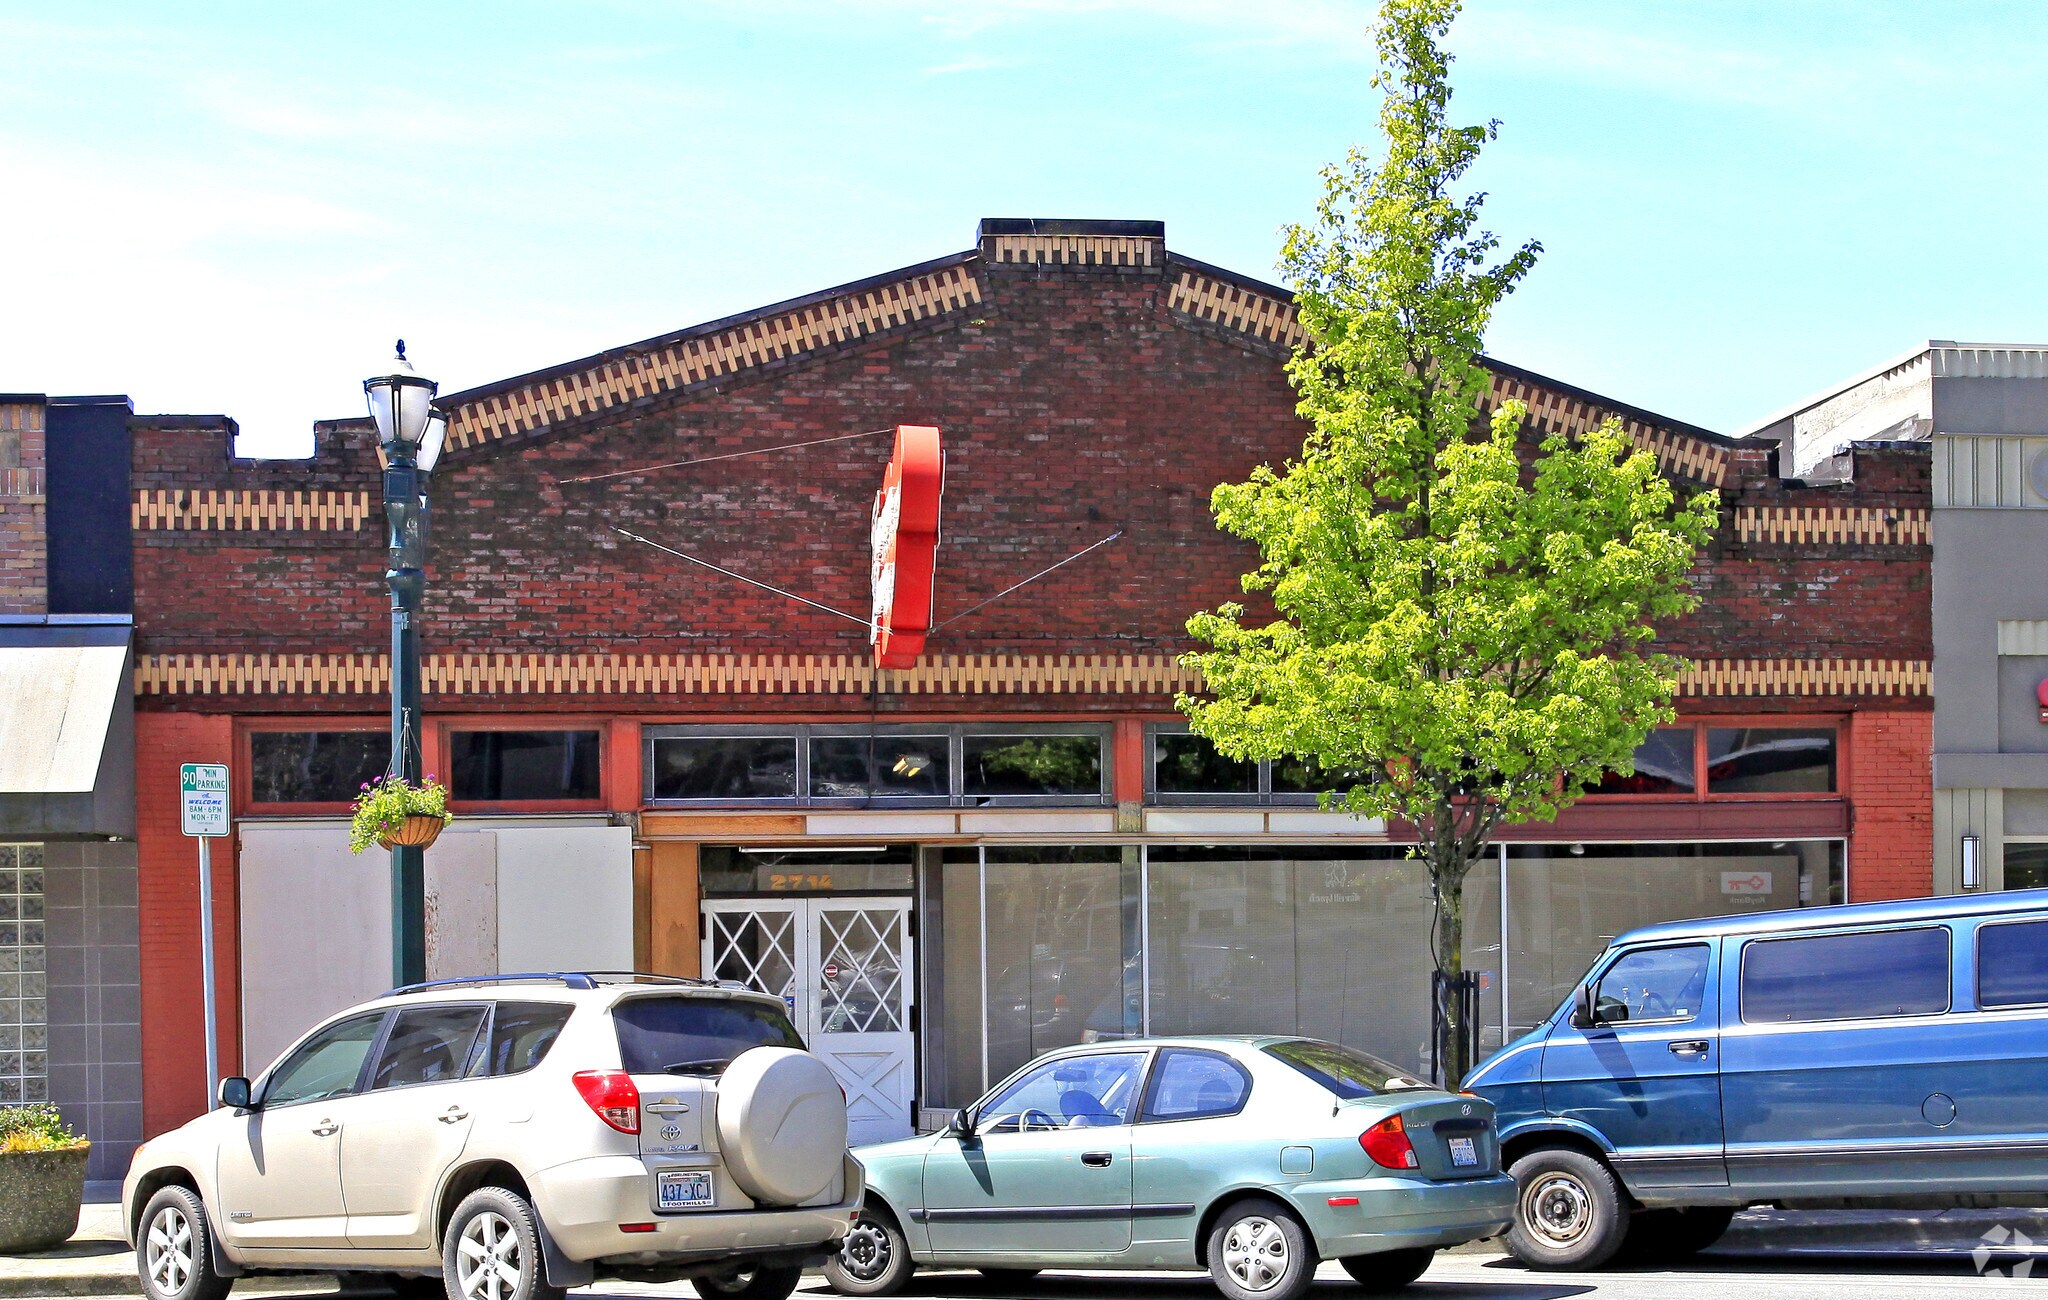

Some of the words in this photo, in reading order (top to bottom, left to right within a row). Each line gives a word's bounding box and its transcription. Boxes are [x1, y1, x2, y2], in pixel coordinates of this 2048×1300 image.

[205, 769, 217, 777] MIN
[183, 772, 196, 785] 90
[197, 780, 226, 789] PARKING
[668, 1144, 699, 1152] RAV4
